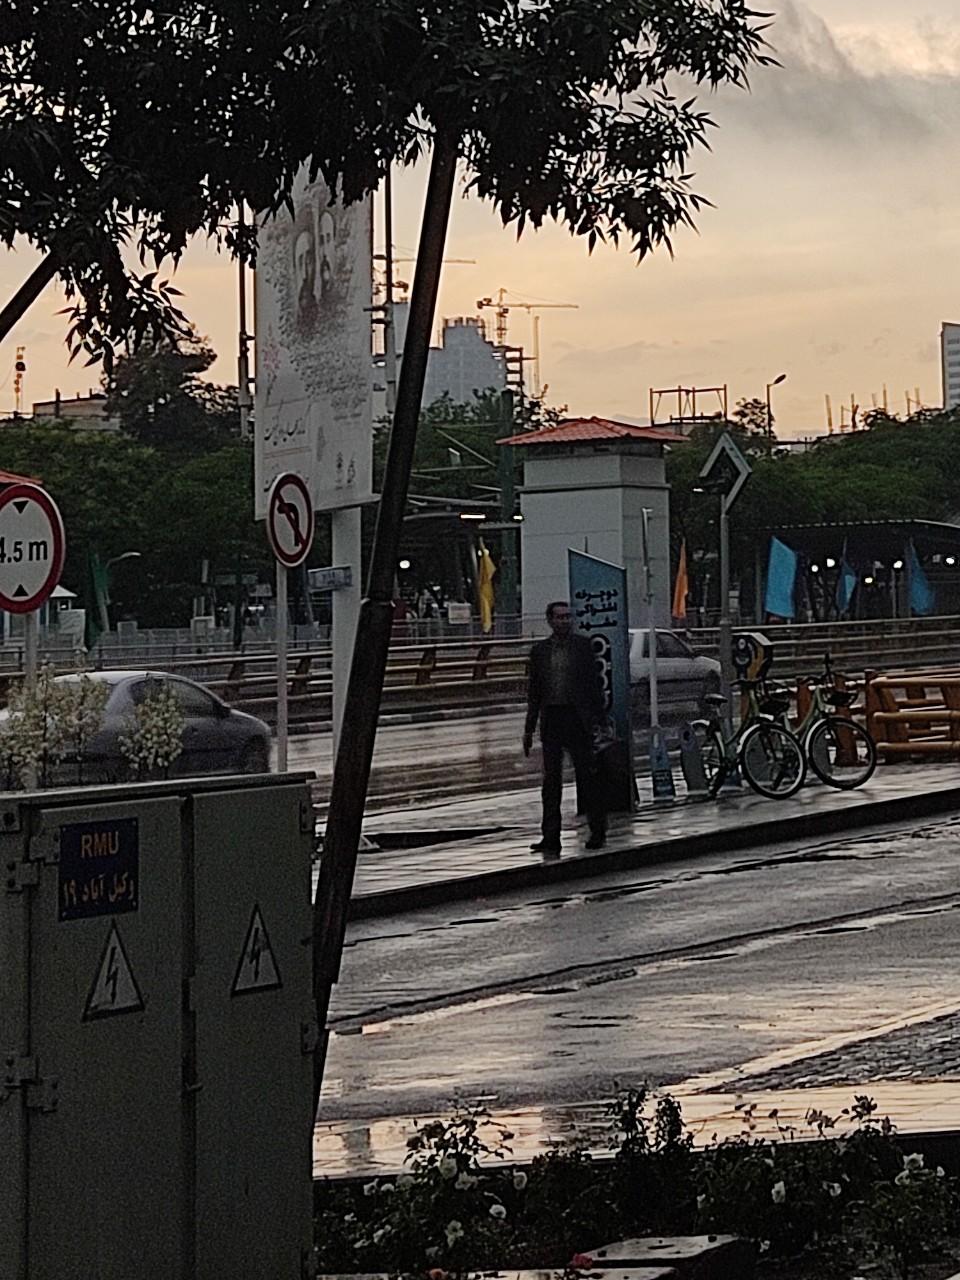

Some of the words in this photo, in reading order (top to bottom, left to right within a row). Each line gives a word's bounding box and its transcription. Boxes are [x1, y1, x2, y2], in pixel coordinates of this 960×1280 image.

[28, 540, 48, 561] m
[575, 588, 618, 603] دوچرخه
[579, 616, 618, 631] مشهد
[80, 830, 119, 858] RMU
[80, 872, 105, 904] آباد
[108, 871, 134, 903] وکیل
